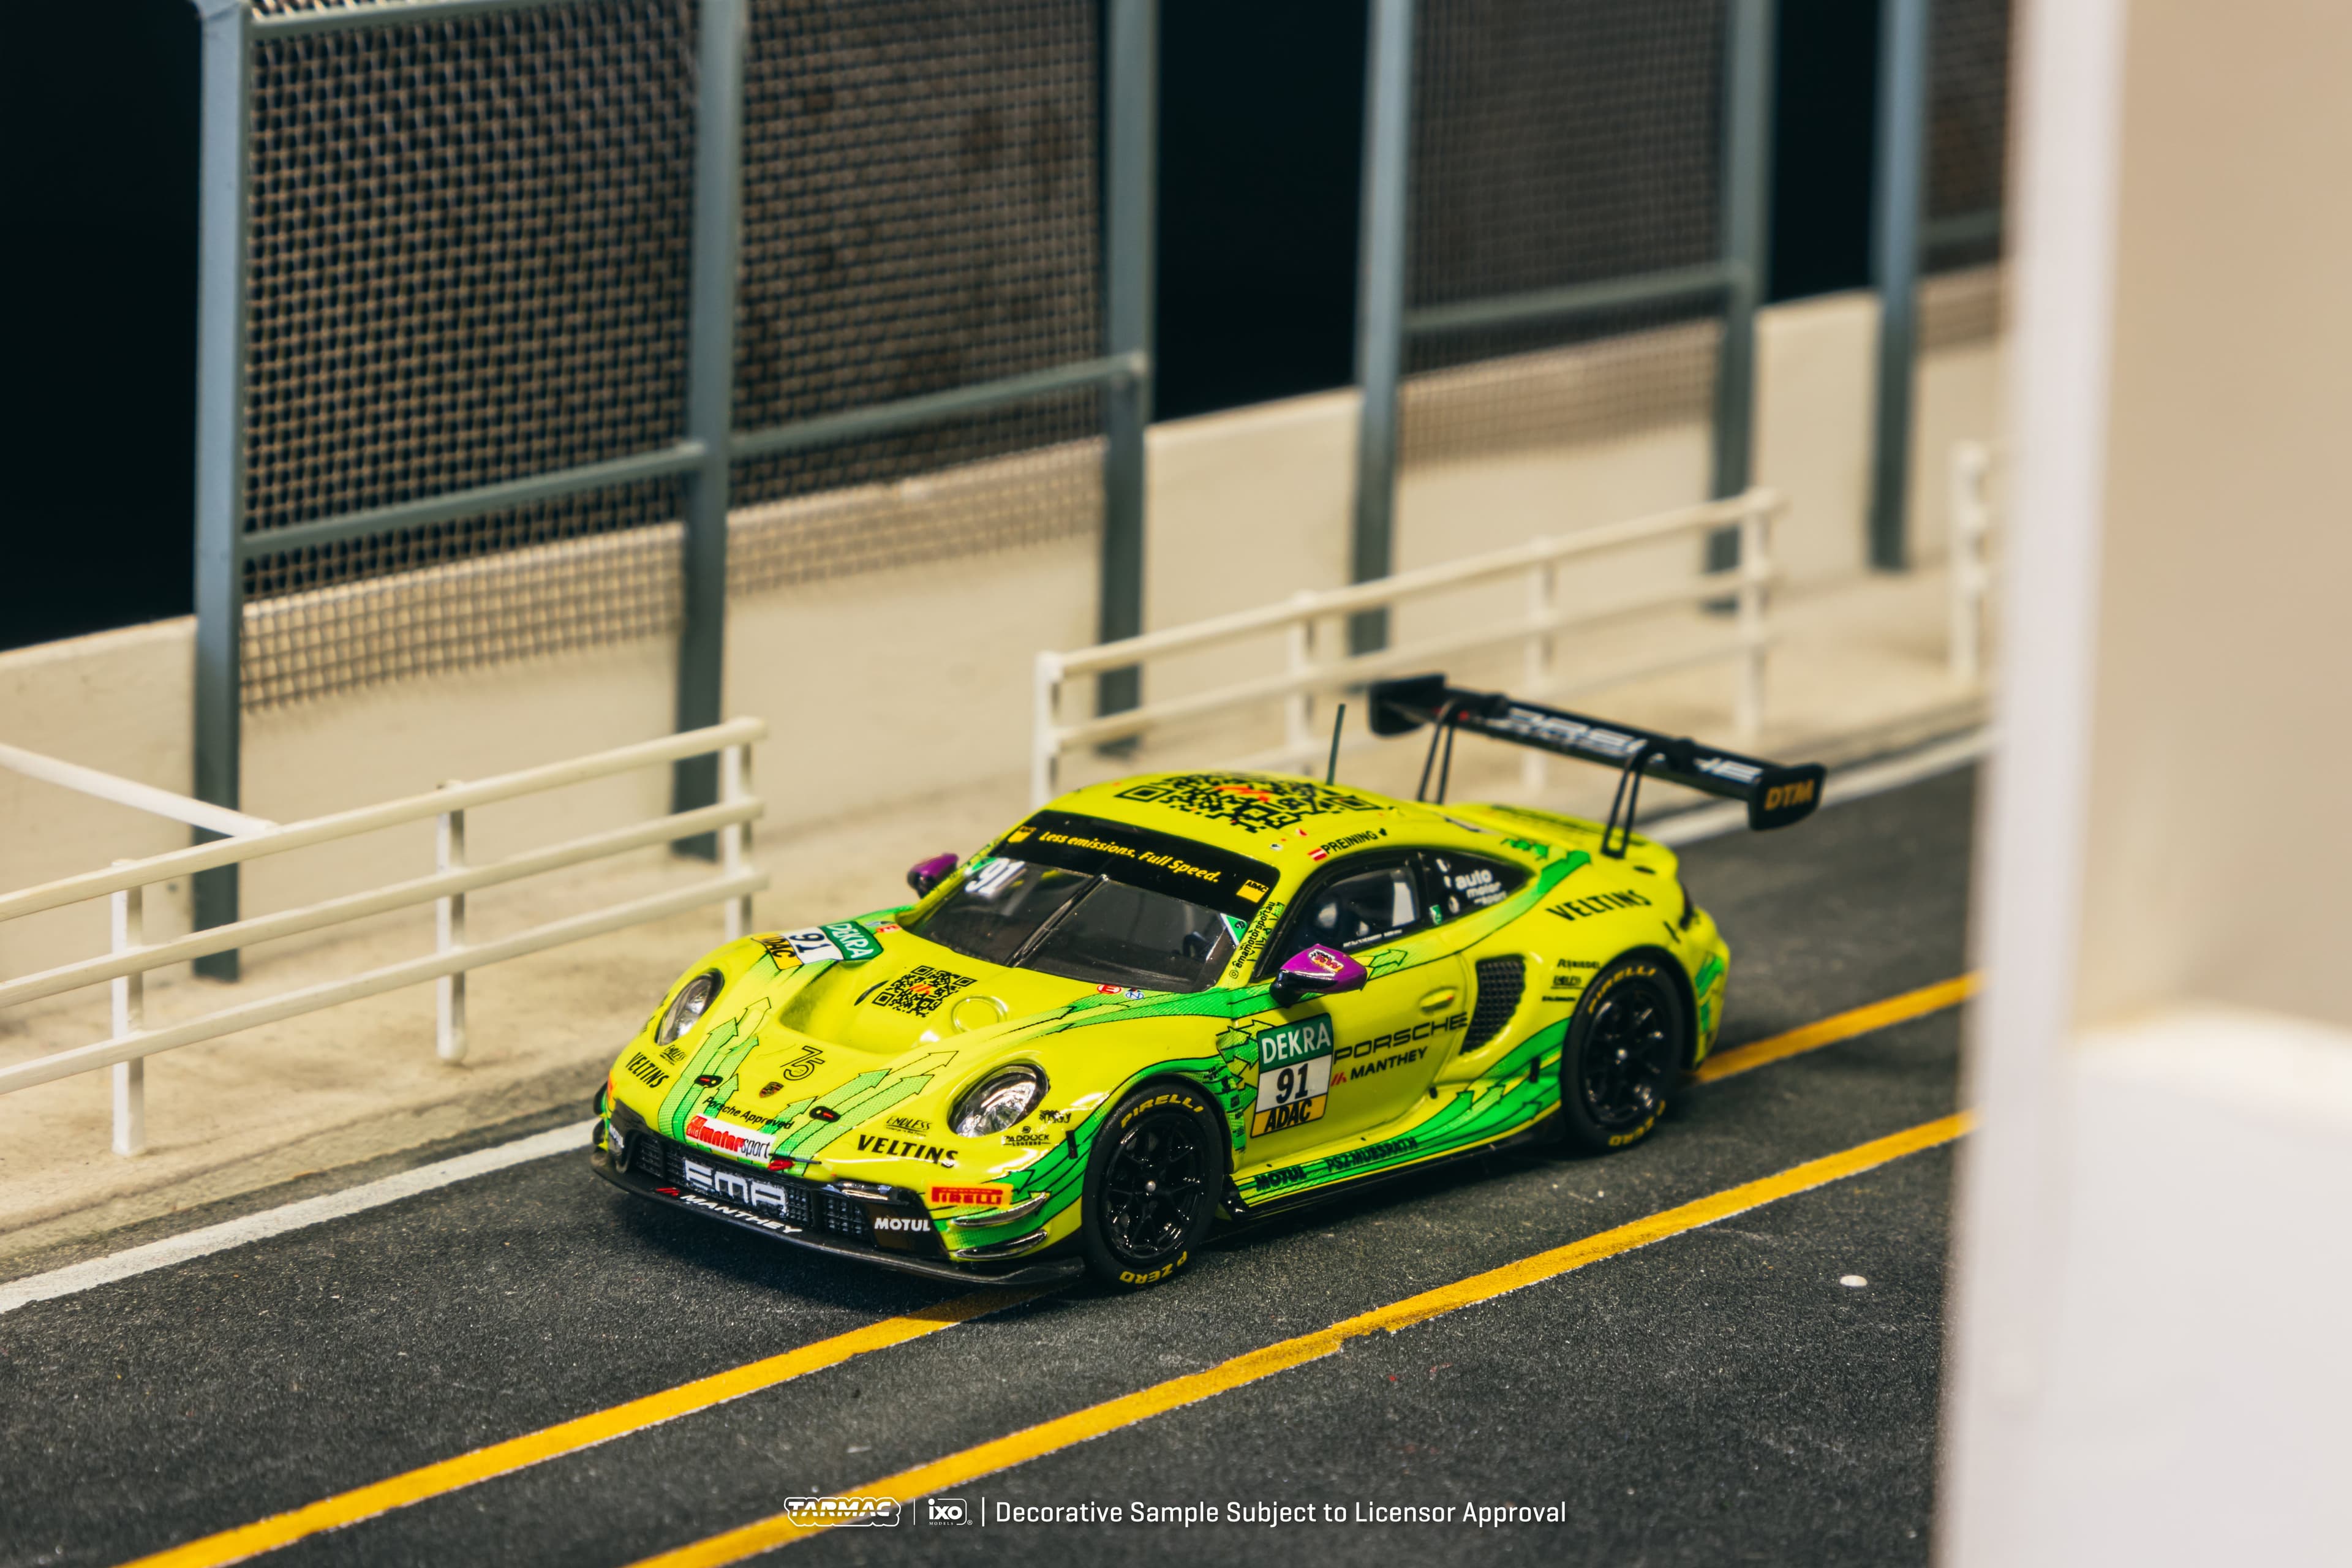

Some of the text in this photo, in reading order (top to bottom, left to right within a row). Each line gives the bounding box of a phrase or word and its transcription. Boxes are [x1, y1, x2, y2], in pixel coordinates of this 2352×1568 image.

[1764, 779, 1814, 810] DTM
[1039, 831, 1221, 883] Less emissions. Full Speed.
[1320, 831, 1378, 854] PREINING
[964, 858, 1025, 895] 91
[1545, 889, 1652, 921] VELTINS
[762, 934, 796, 958] DAC
[789, 932, 832, 953] 91
[827, 923, 874, 959] DEKRA
[1261, 1022, 1332, 1065] DEKRA
[1333, 1012, 1468, 1065] PORSCHE
[625, 1051, 670, 1088] VELTINS
[1350, 1046, 1428, 1080] MANTHEY
[1276, 1063, 1309, 1104] 91
[702, 1096, 795, 1129] Porsche Approved
[886, 1115, 933, 1131] ENDLESS
[1120, 1094, 1204, 1128] PIRELLI
[1264, 1098, 1313, 1133] ADAC
[857, 1134, 959, 1169] VELTINS
[932, 1186, 1004, 1205] PIRELLI
[1254, 1166, 1307, 1192] MOTUL
[679, 1194, 803, 1234] MANTHEY
[874, 1217, 931, 1232] MOTUL
[1119, 1250, 1188, 1284] P ZERO
